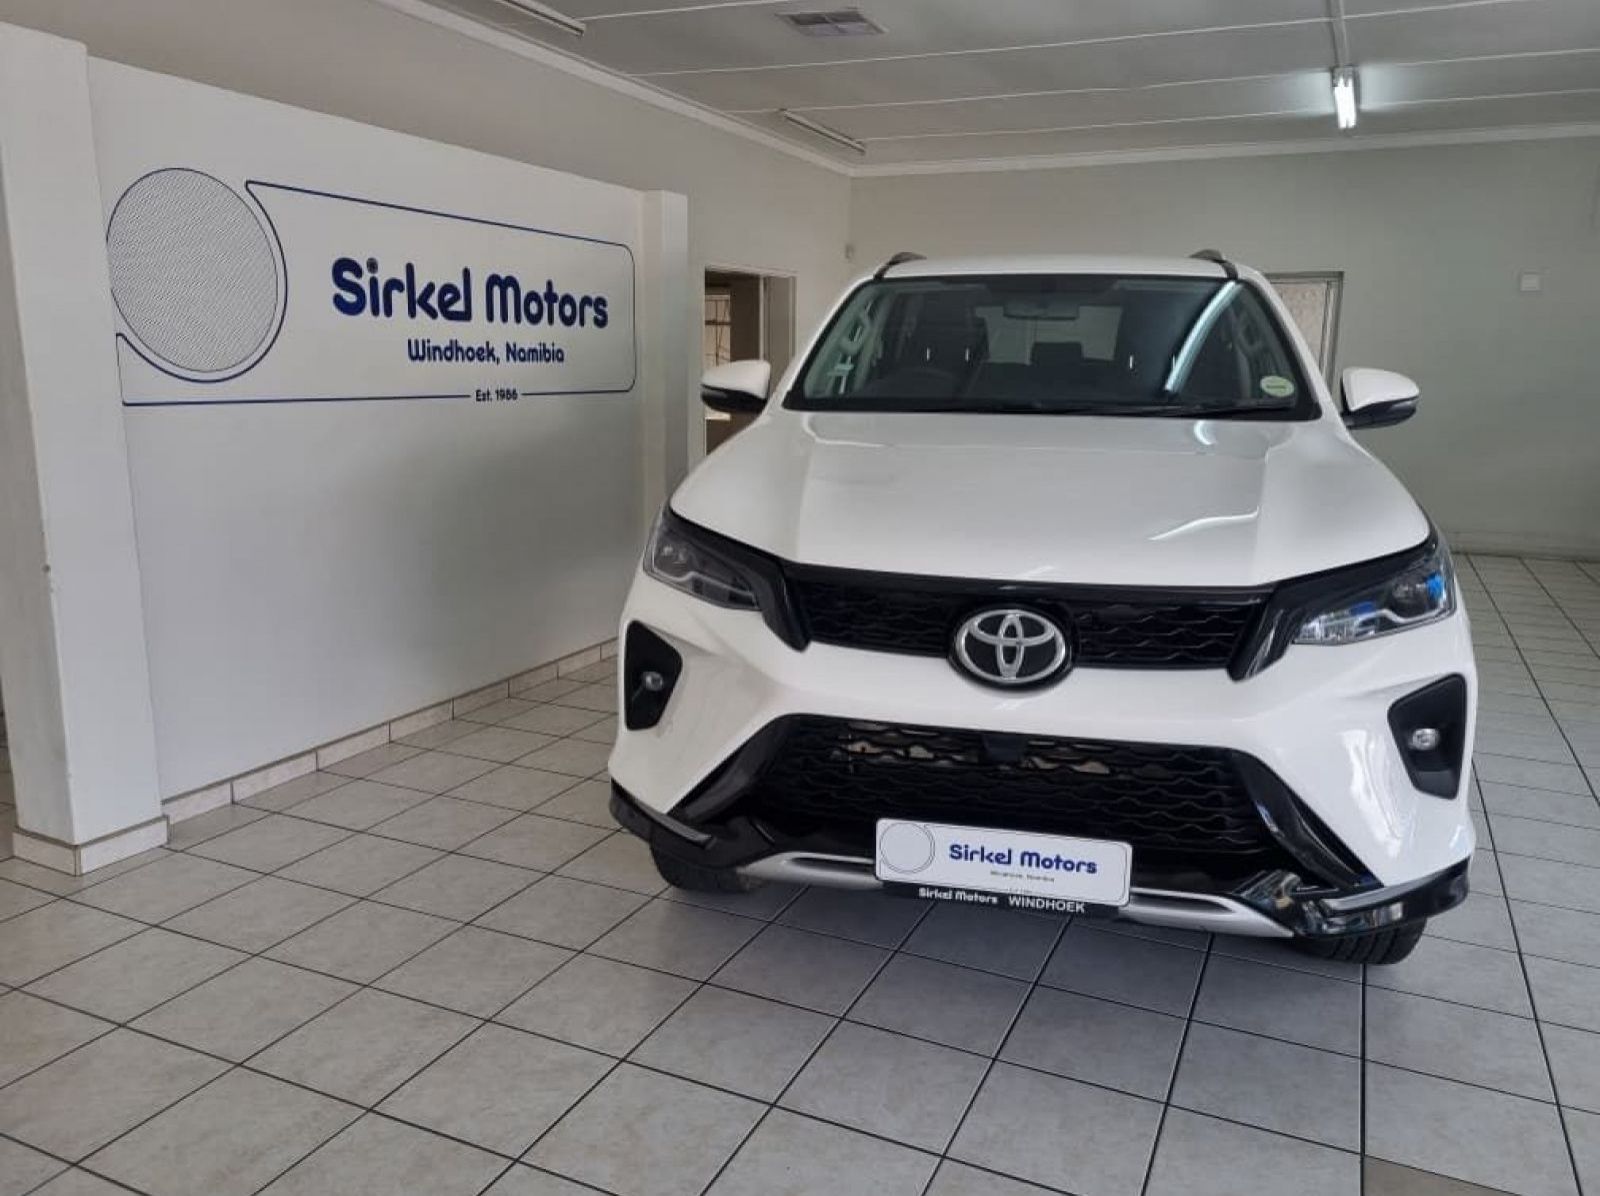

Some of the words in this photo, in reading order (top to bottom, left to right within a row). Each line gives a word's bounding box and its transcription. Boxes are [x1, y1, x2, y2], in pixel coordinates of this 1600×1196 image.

[332, 257, 472, 322] Sirkel
[485, 273, 609, 329] Motors
[407, 338, 500, 365] Windhoek,
[506, 341, 565, 363] Namibia
[475, 388, 493, 402] Est.
[949, 844, 1012, 865] Sirkel
[1020, 850, 1098, 874] Motors
[918, 887, 953, 900] Sirkel
[955, 890, 998, 904] Motors
[1008, 895, 1086, 914] WINDHOEK
